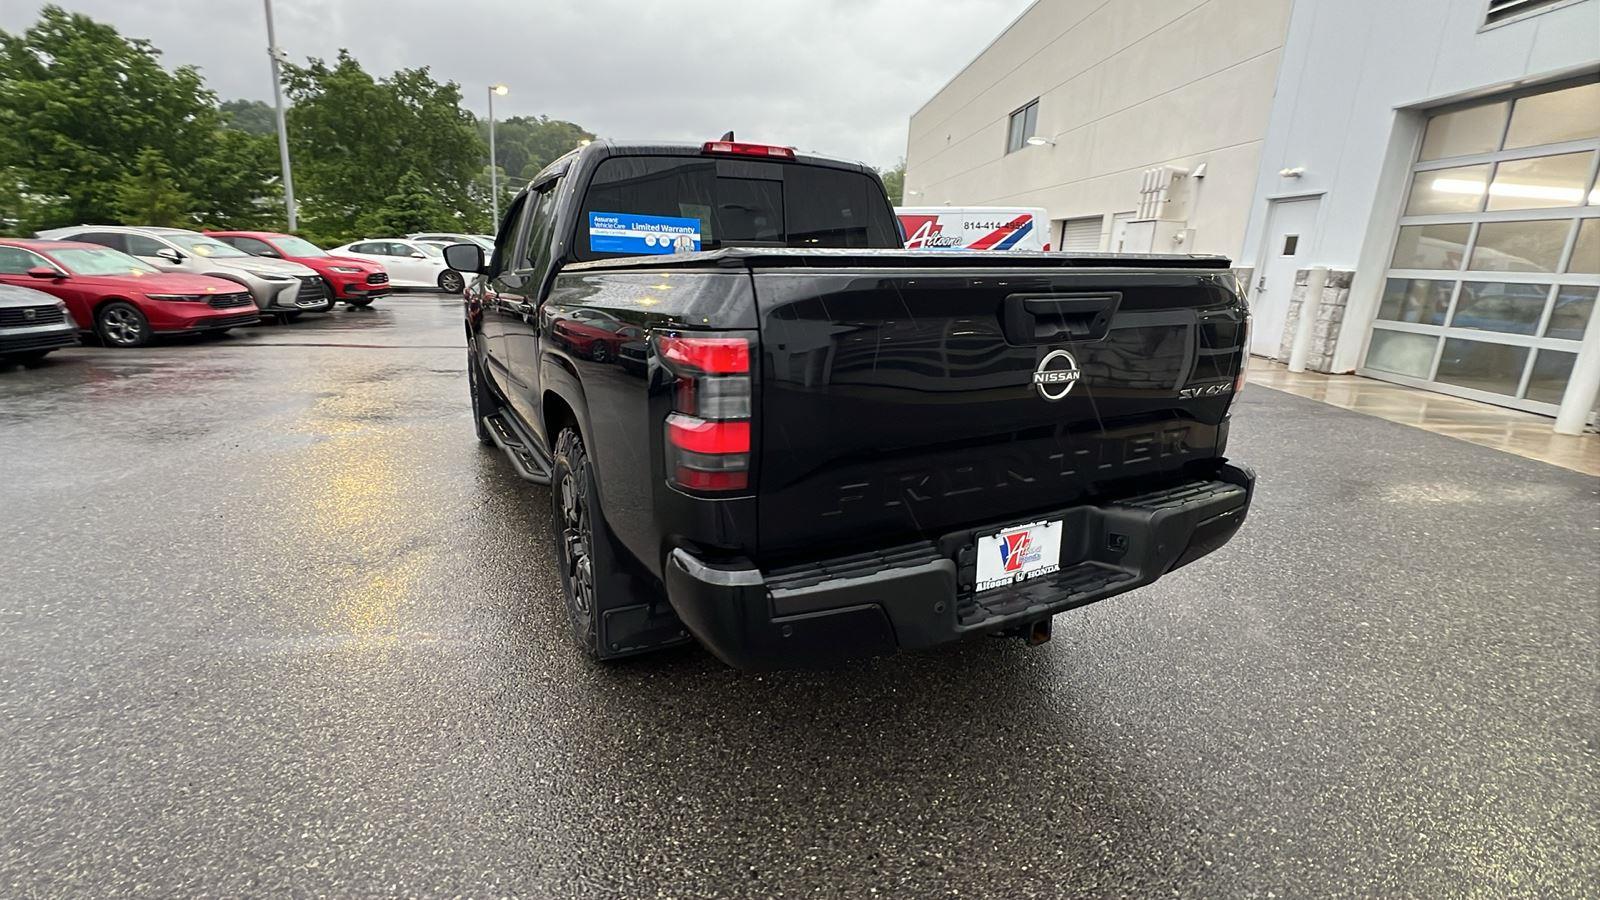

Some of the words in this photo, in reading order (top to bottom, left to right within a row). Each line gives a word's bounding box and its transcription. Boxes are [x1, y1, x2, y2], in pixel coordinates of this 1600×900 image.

[631, 222, 660, 232] Limited
[660, 224, 695, 234] Warranty
[904, 220, 962, 248] Altoona
[1034, 371, 1080, 382] NISSAN
[1179, 387, 1203, 399] SV
[819, 426, 1190, 517] FRONTIER
[976, 575, 1013, 592] Altoona
[1027, 563, 1060, 579] HONDA
